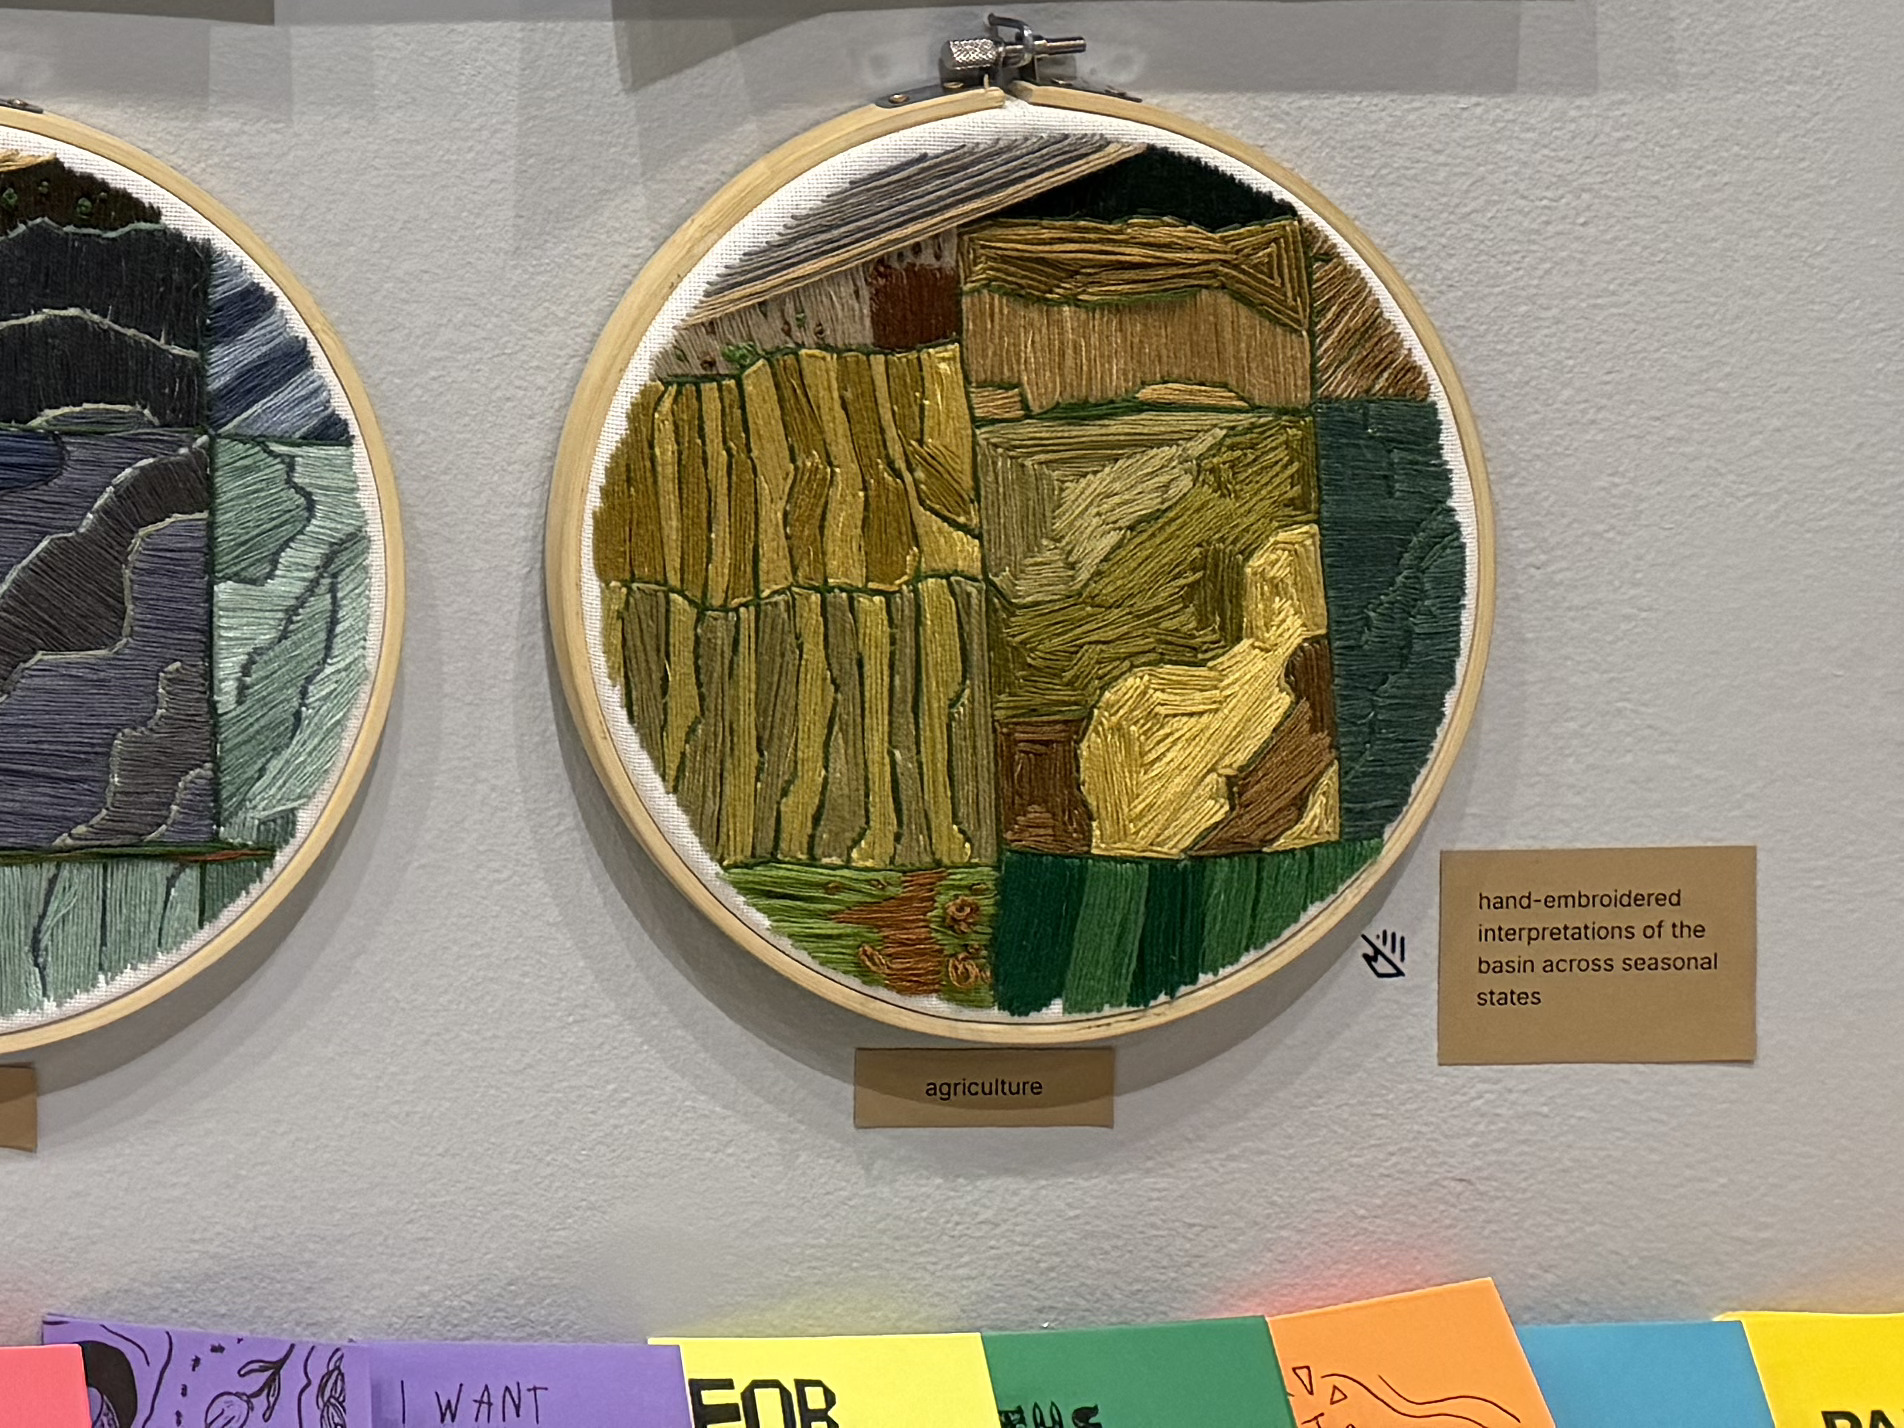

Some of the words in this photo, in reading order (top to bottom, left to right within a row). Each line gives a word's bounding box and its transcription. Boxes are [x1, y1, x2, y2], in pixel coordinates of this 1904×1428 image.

[1479, 889, 1681, 909] hand-embroidered
[1479, 924, 1635, 946] interpretations
[1643, 920, 1663, 939] of
[1672, 921, 1705, 938] the
[1479, 957, 1534, 974] basin
[1543, 958, 1614, 973] across
[1622, 953, 1717, 971] seasonal
[1477, 989, 1541, 1006] states
[926, 1078, 1042, 1101] agriculture
[434, 1384, 550, 1426] WANT
